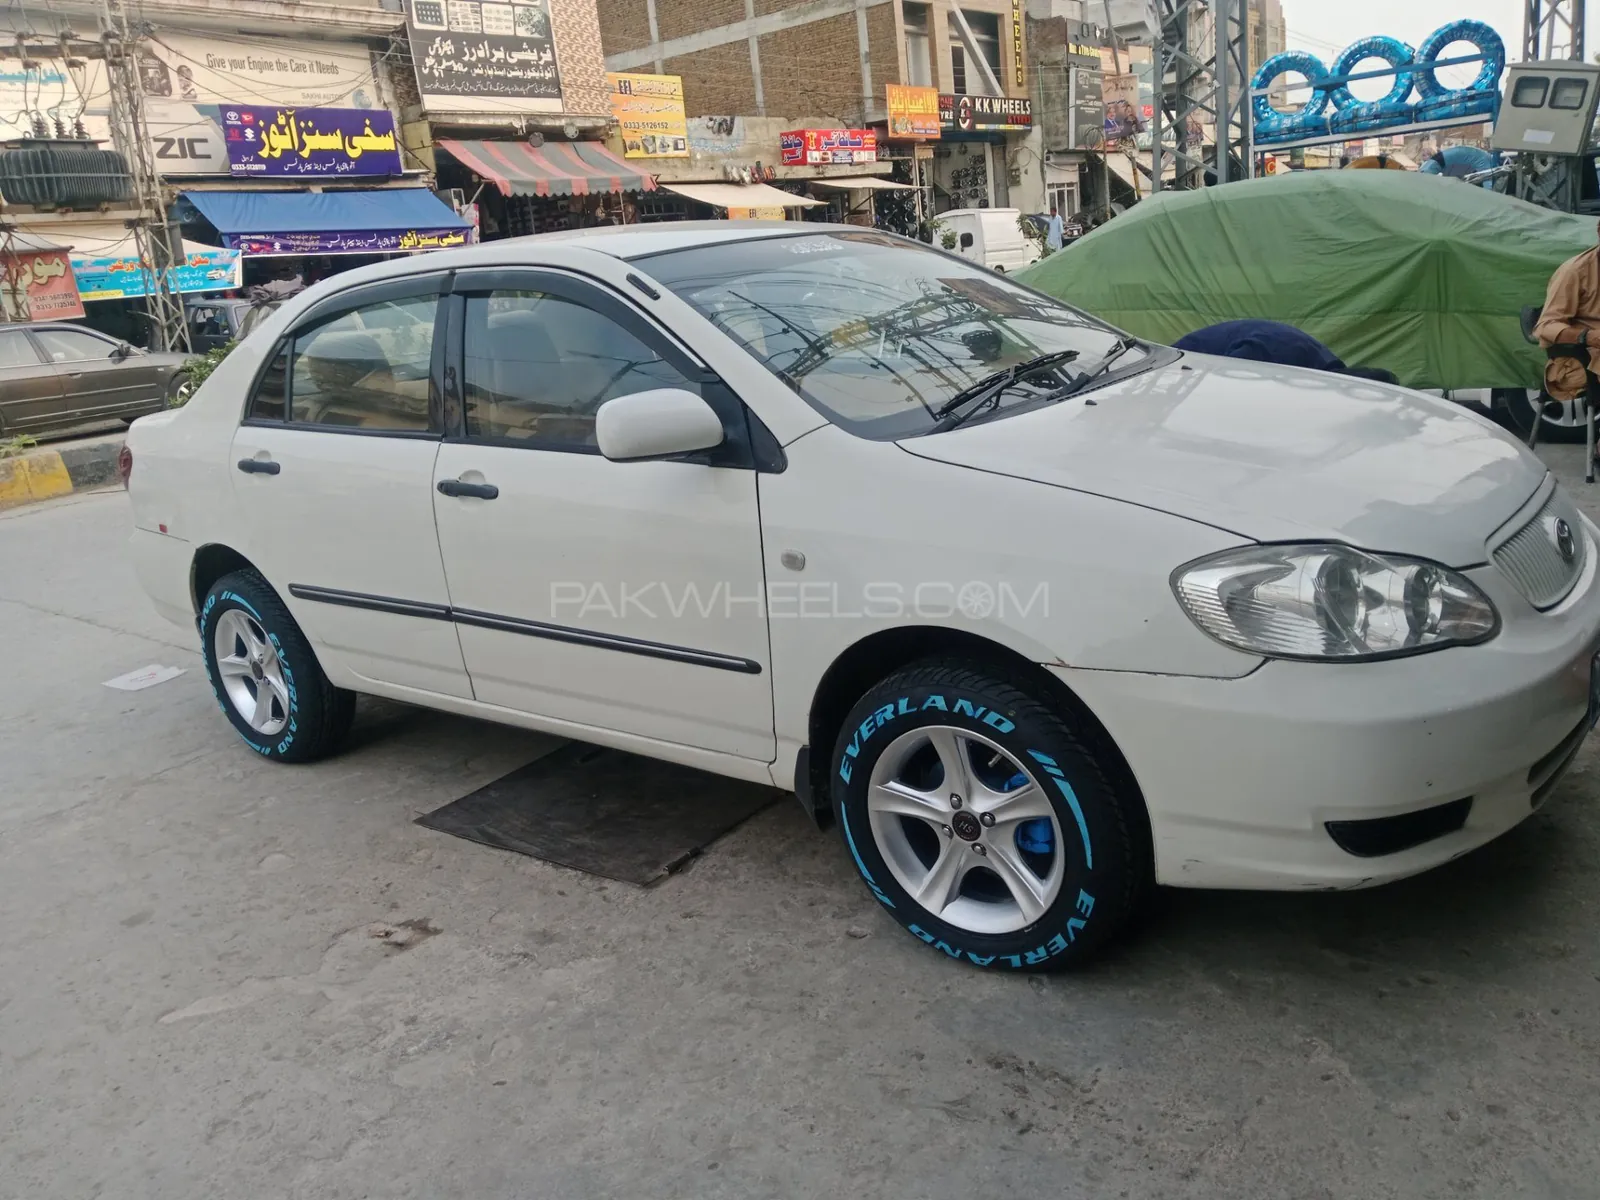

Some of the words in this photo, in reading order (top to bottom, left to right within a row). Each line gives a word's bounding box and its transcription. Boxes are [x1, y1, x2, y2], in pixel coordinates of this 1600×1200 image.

[461, 40, 507, 62] برادرز
[506, 41, 553, 64] قریشی
[206, 53, 227, 69] Give
[228, 59, 246, 72] your
[248, 56, 274, 73] Engine
[275, 59, 289, 72] the
[289, 60, 307, 74] Care
[316, 61, 340, 75] Needs
[618, 79, 632, 94] EFI
[939, 97, 954, 108] ONE
[975, 97, 991, 113] KK
[991, 98, 1031, 115] WHEELS
[939, 110, 954, 120] YRE
[257, 110, 299, 159] آٹوز
[299, 120, 345, 159] سنز
[345, 118, 396, 158] سخی
[152, 137, 212, 160] ZIC
[418, 233, 440, 250] سنز
[439, 231, 465, 247] سخی
[269, 632, 299, 755] EVERLAND
[838, 695, 1016, 785] EVERLAND
[908, 888, 1096, 968] EVERLAND
